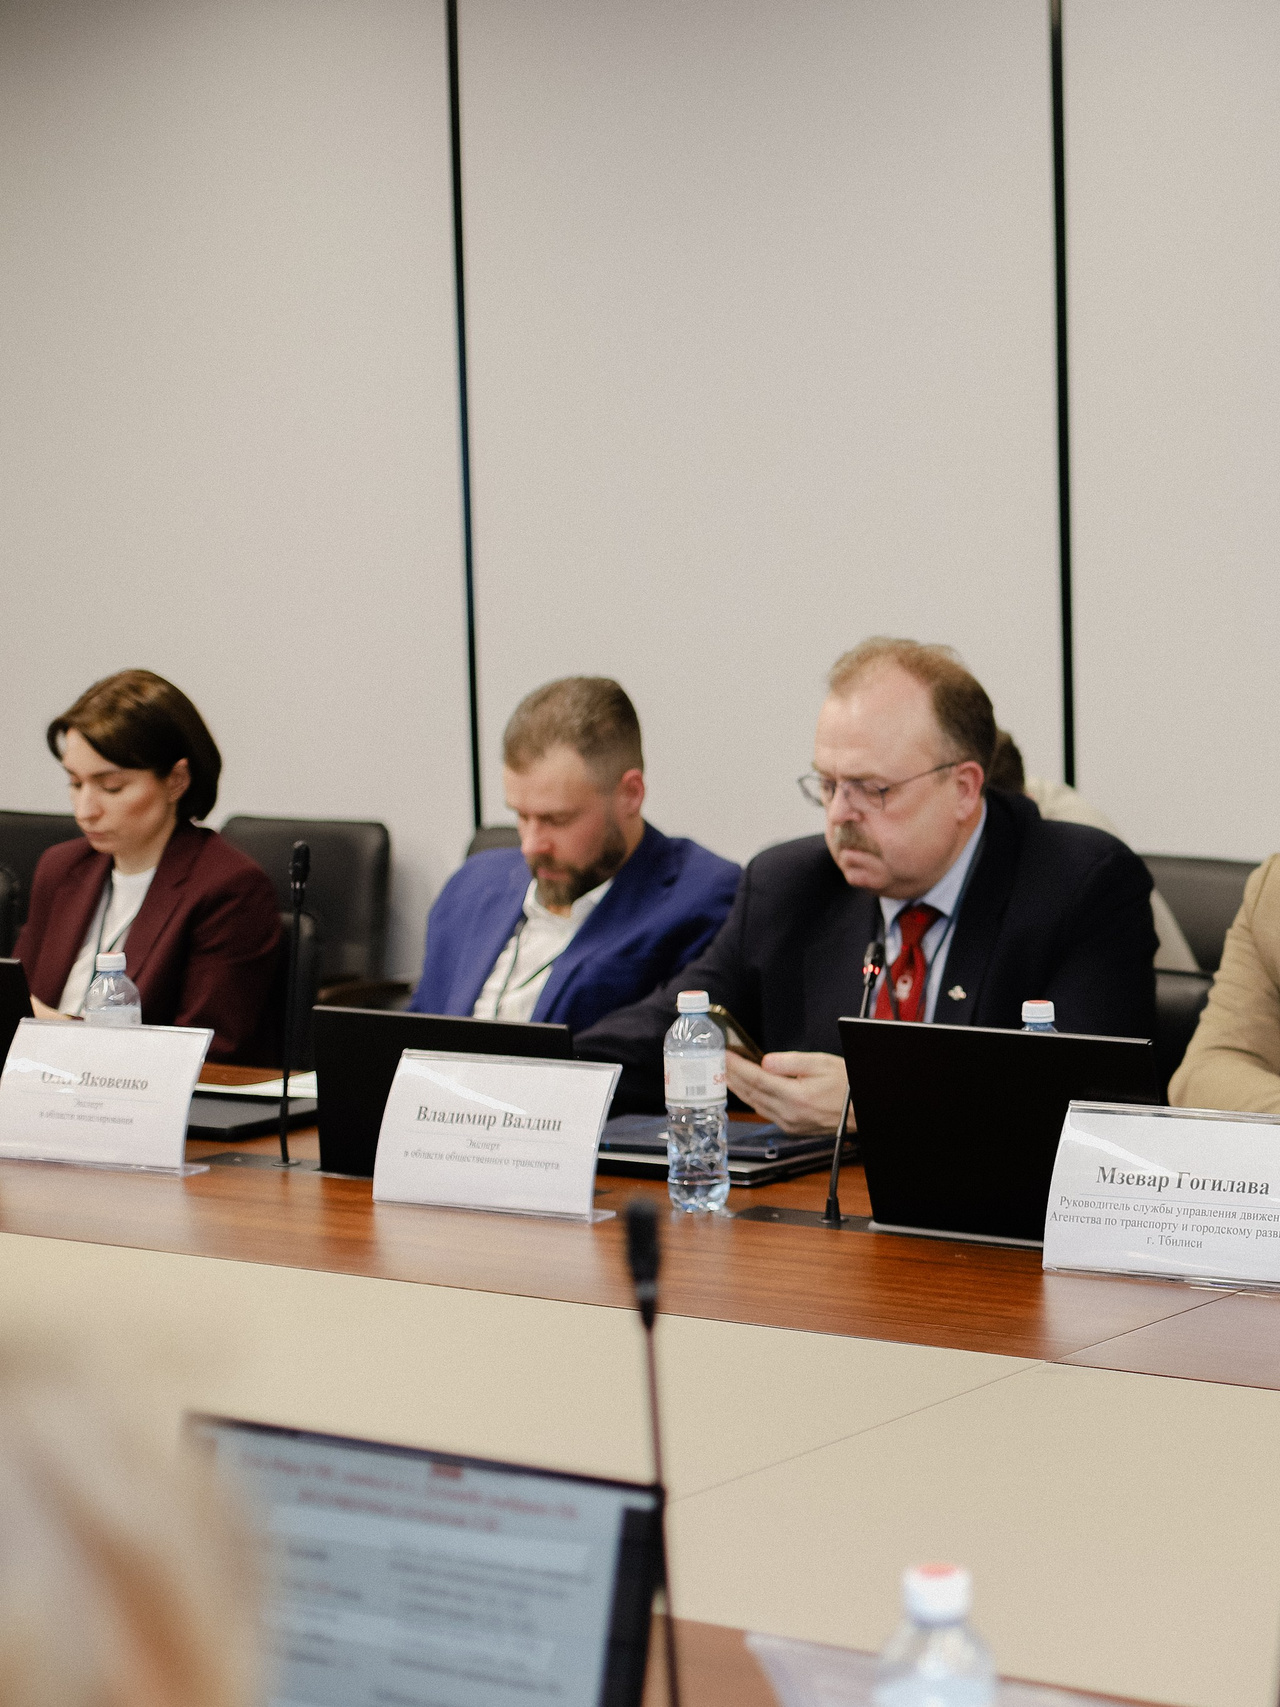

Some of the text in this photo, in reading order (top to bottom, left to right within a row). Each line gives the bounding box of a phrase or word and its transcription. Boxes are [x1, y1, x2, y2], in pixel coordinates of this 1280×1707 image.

[77, 1071, 149, 1090] Яковенко
[416, 1105, 562, 1132] Владимир Валдин
[466, 1138, 501, 1151] Эксперт
[410, 1149, 444, 1161] области
[445, 1152, 510, 1165] общественного
[512, 1158, 560, 1171] транспорта
[1096, 1166, 1270, 1195] Мзевар Гогилава
[1059, 1196, 1131, 1212] Руководитель
[1133, 1203, 1173, 1216] службы
[1176, 1206, 1237, 1220] управления
[1049, 1211, 1101, 1225] Агентства
[1104, 1218, 1117, 1226] по
[1120, 1218, 1178, 1232] транспорту
[1181, 1223, 1188, 1231] и
[1191, 1224, 1252, 1238] городскому
[1146, 1235, 1203, 1248] г. Тбилиси
